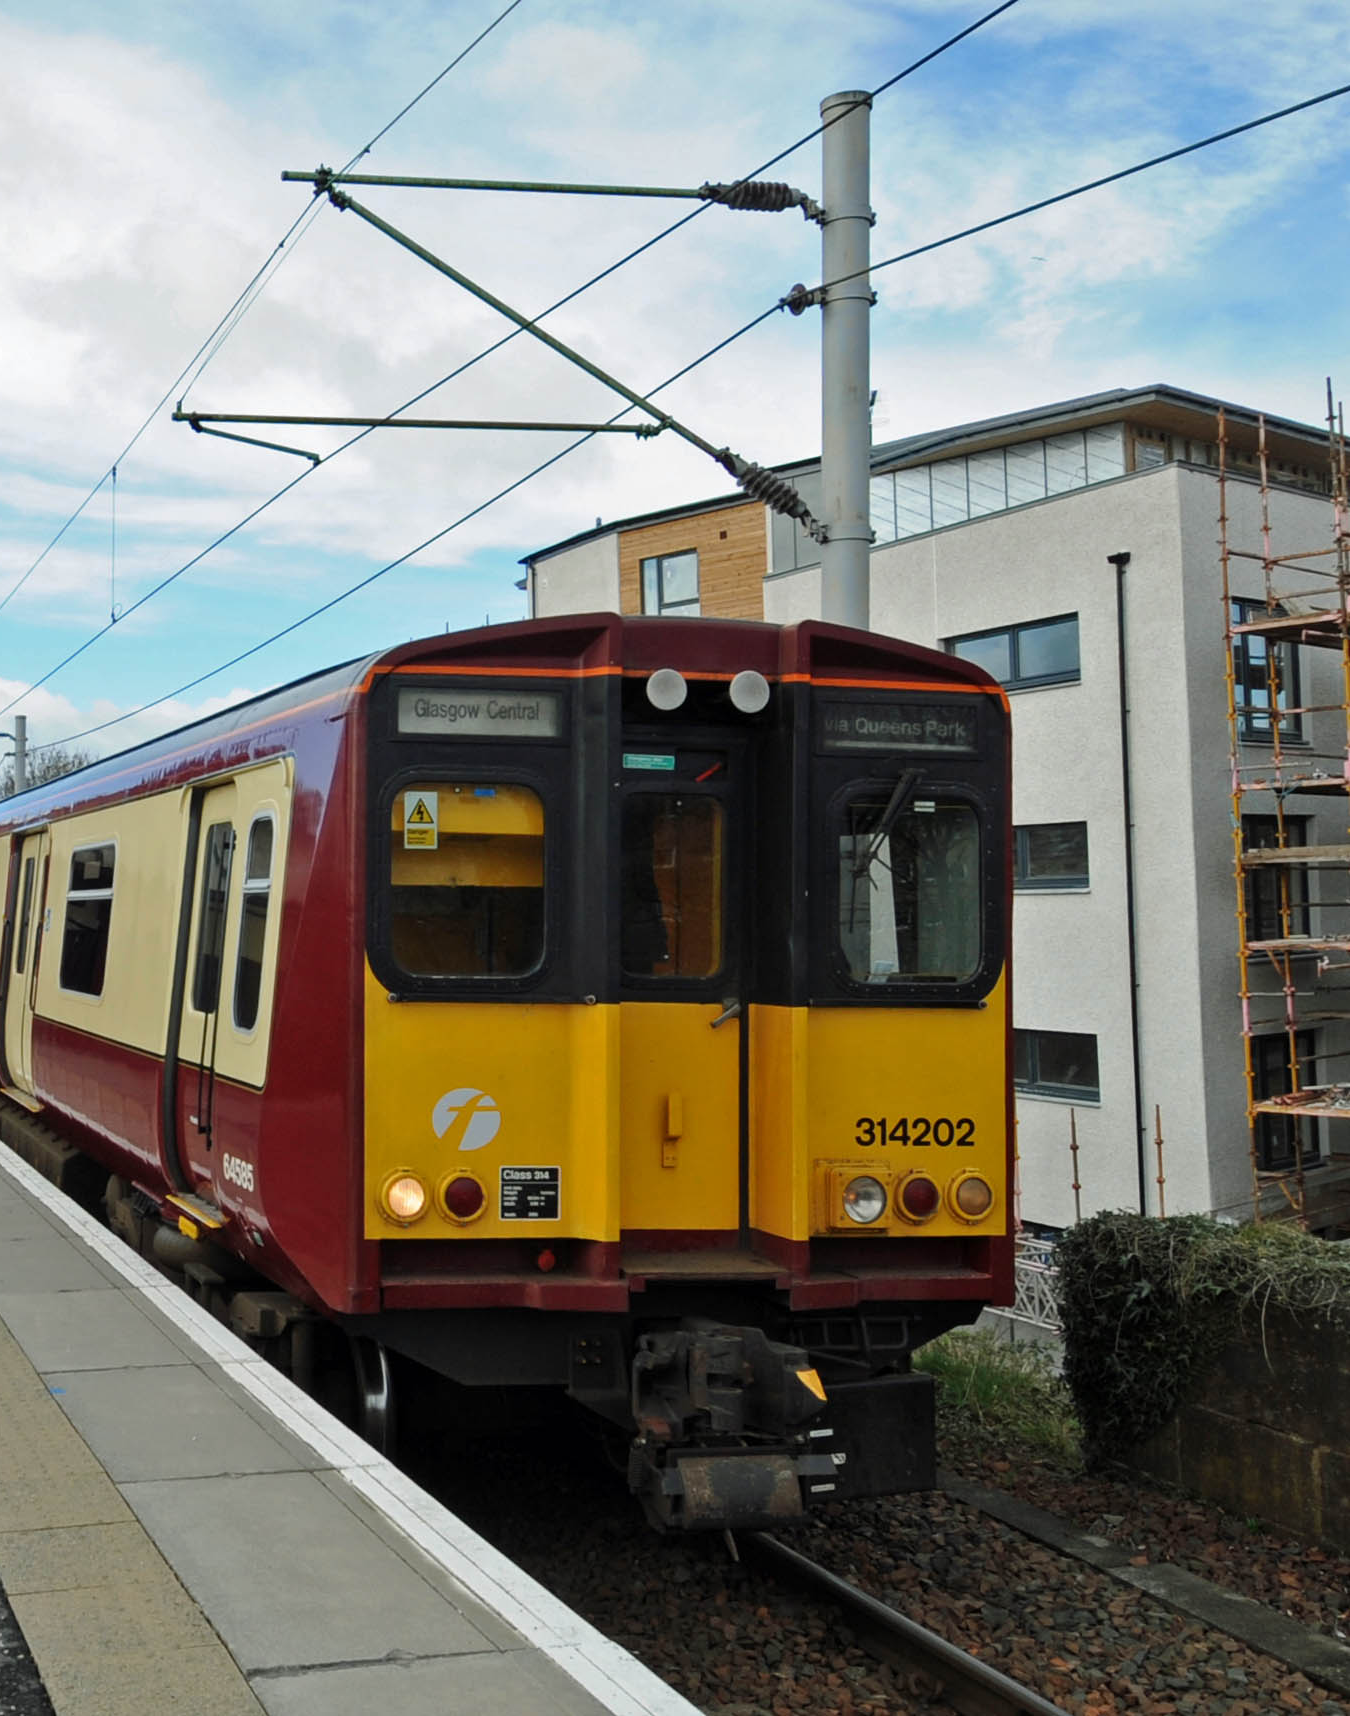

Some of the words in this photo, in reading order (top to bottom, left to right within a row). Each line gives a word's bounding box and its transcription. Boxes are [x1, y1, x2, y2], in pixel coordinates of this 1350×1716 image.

[414, 698, 480, 722] Glasgow
[486, 700, 540, 721] Central
[824, 718, 849, 732] via
[855, 717, 922, 736] Queens
[925, 720, 967, 737] Park
[855, 1117, 975, 1147] 314202
[223, 1152, 254, 1192] 64585
[503, 1170, 532, 1180] Class
[534, 1171, 550, 1180] 314
